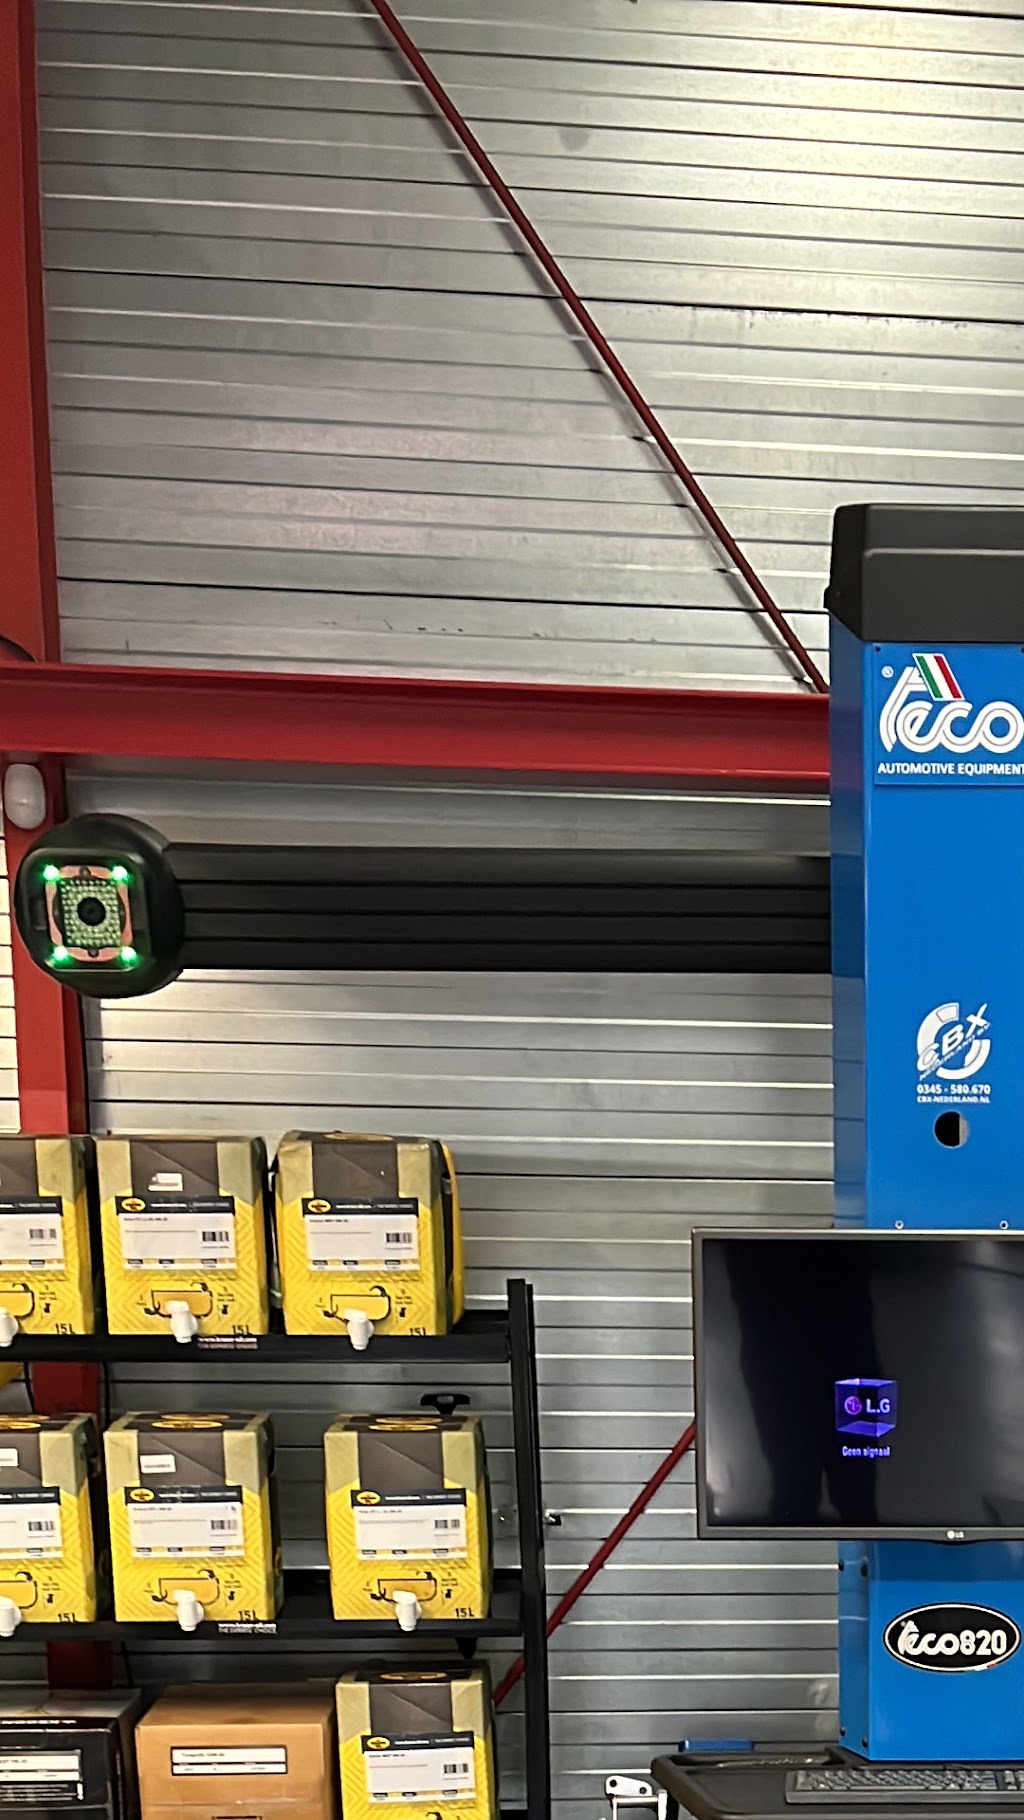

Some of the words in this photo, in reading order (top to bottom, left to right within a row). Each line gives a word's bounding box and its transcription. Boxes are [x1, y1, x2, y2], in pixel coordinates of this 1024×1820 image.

[877, 763, 955, 774] AUTOMOTIVE
[917, 1083, 942, 1094] 0345
[950, 1083, 991, 1095] 580.670
